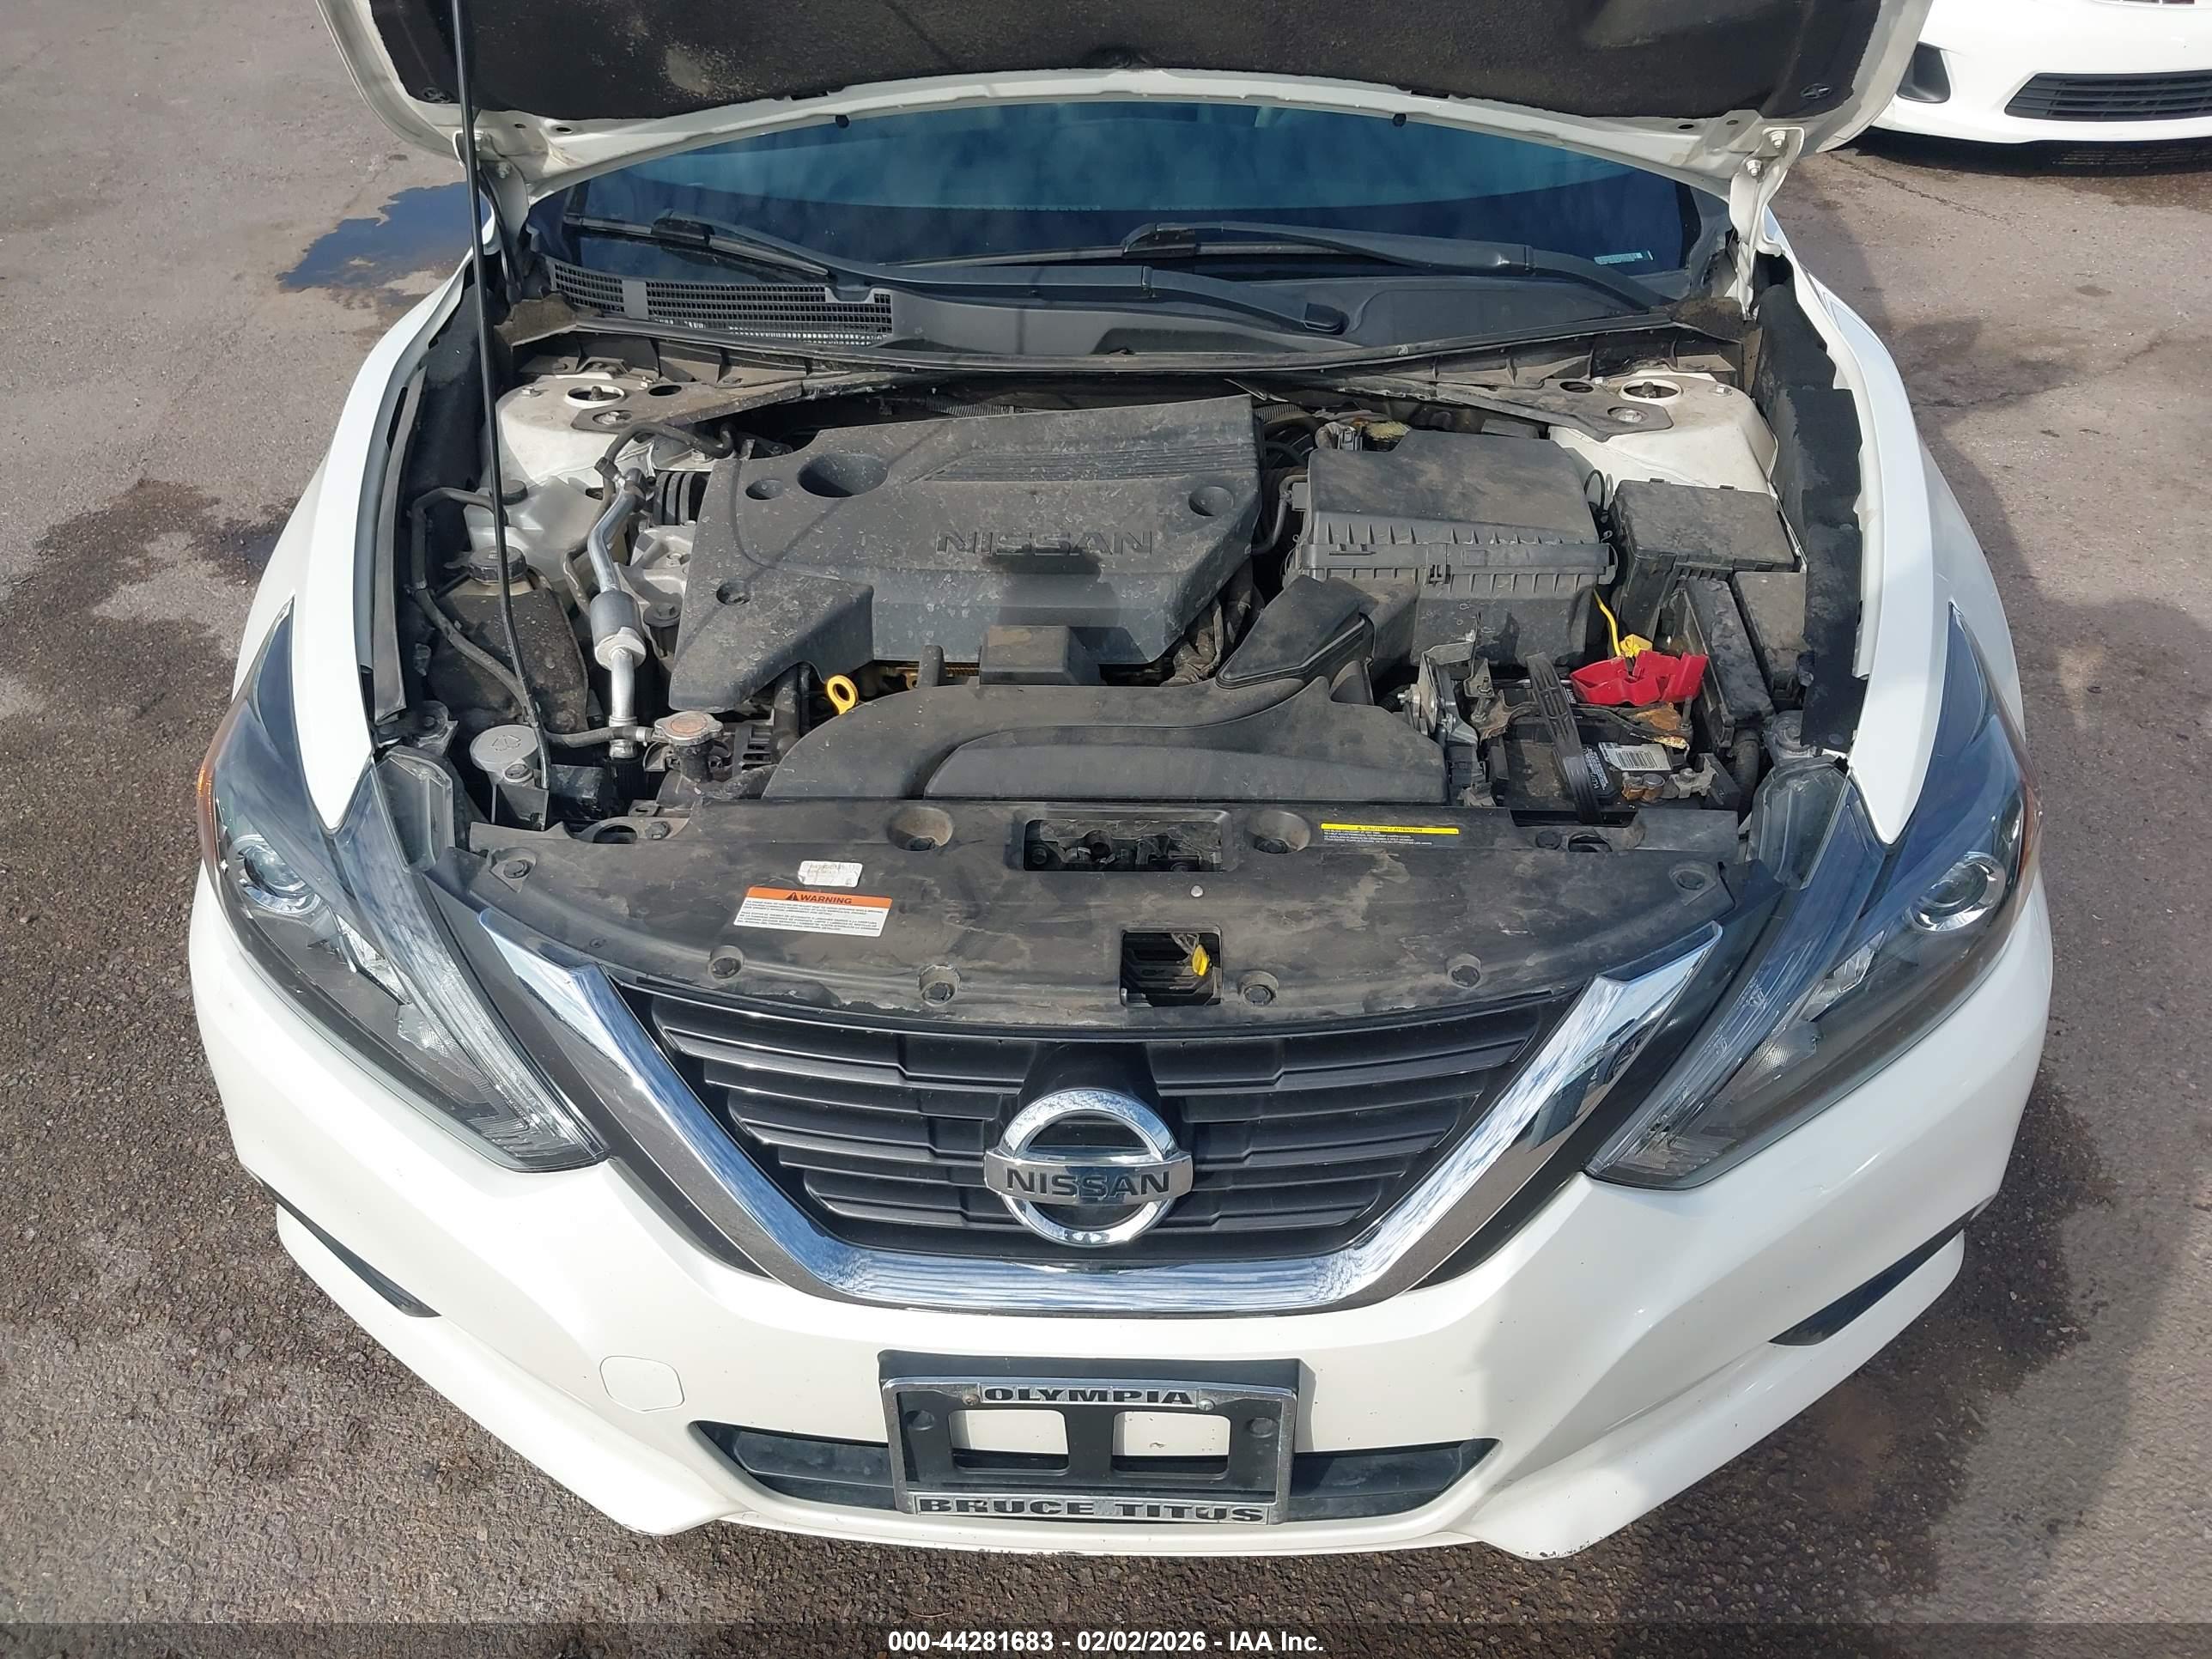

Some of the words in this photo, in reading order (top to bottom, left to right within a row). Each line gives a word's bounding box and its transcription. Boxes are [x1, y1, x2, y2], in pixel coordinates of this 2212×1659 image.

[936, 531, 1152, 556] NISSAN
[800, 894, 853, 905] WARNING
[1006, 1168, 1170, 1199] NISSAN
[983, 1387, 1193, 1406] OLYMPIA
[918, 1498, 1095, 1516] BRUCE
[1115, 1503, 1265, 1522] TITUS
